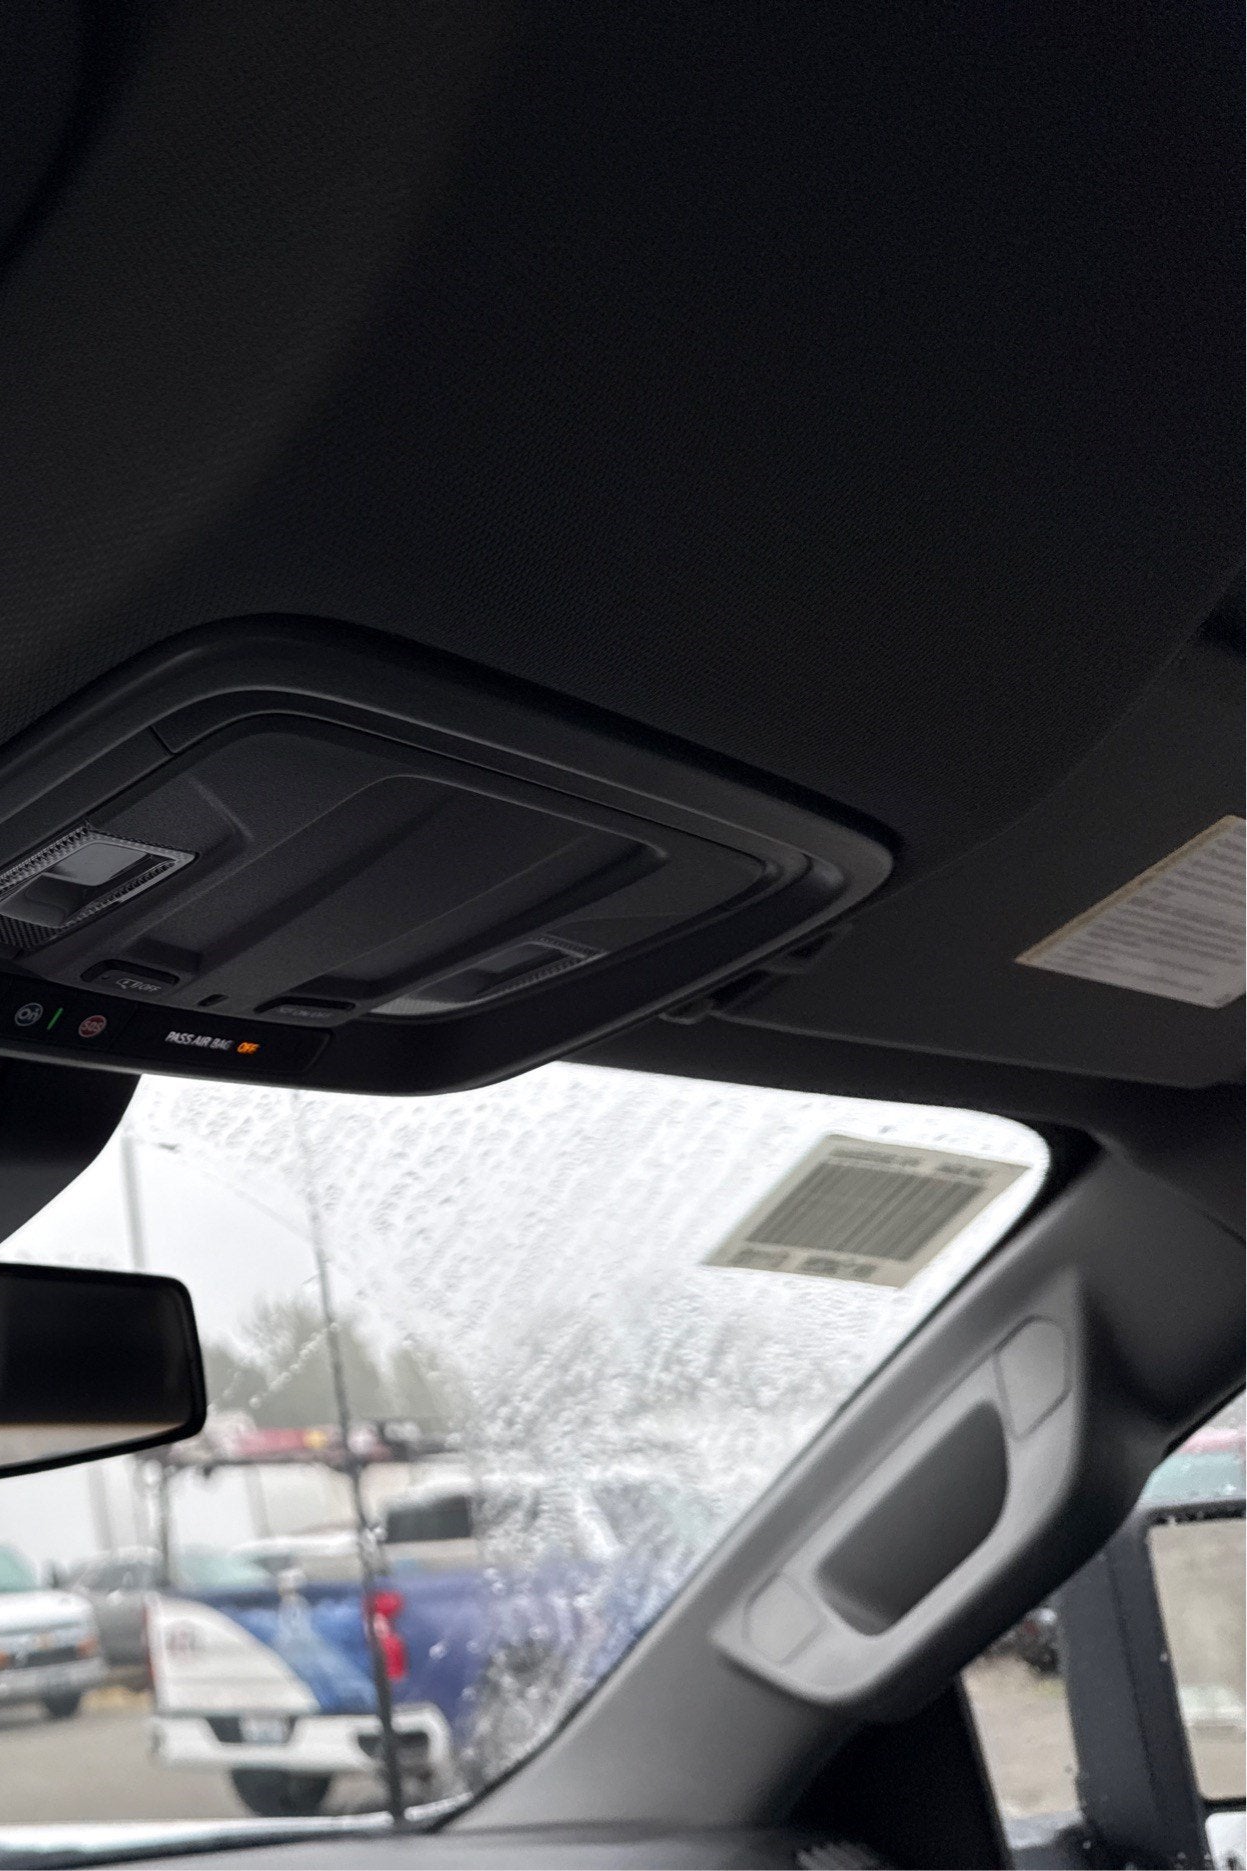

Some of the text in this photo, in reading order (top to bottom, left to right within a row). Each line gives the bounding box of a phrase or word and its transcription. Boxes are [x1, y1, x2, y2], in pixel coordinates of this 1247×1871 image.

[81, 1019, 104, 1032] SOS
[165, 1031, 260, 1054] PASS AIR BAG OFF
